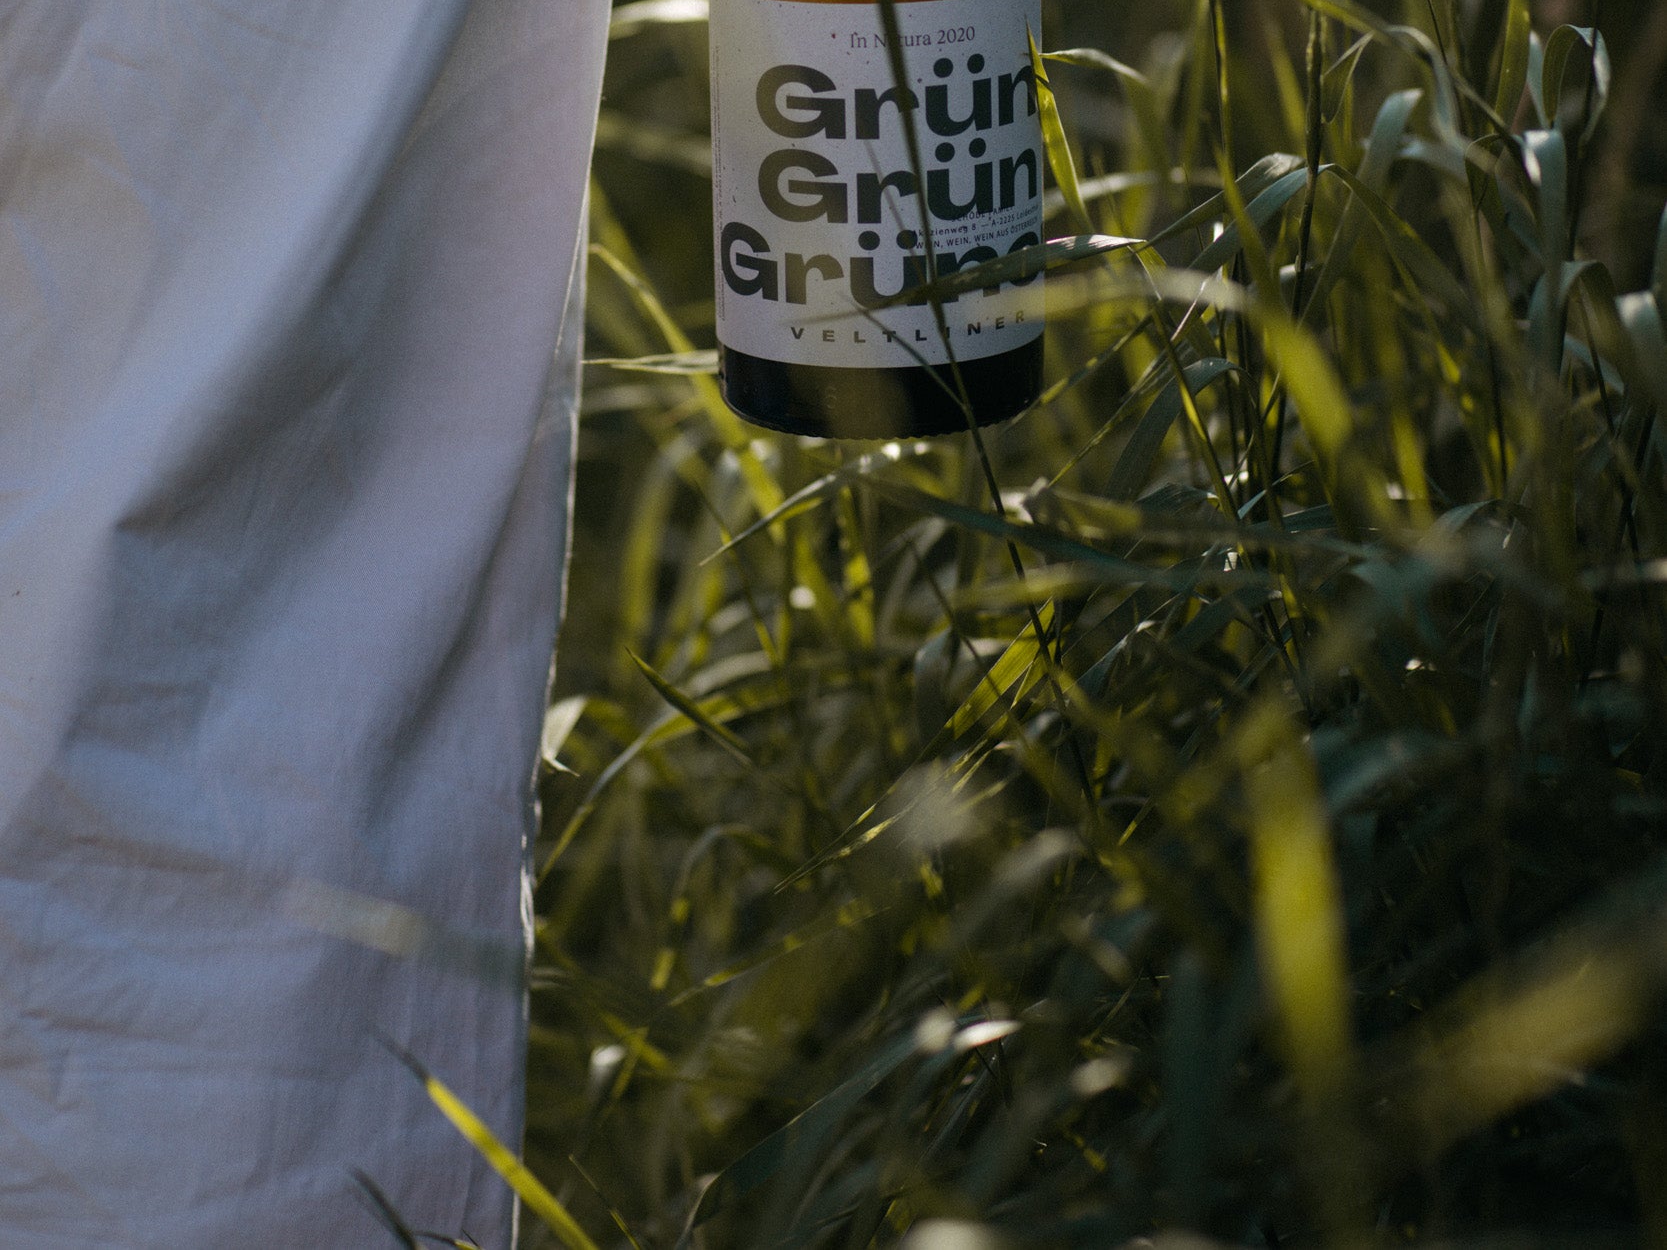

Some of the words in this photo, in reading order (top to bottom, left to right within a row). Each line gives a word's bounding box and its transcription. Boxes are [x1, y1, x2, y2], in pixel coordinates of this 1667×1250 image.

[874, 32, 932, 49] Ntura
[937, 26, 976, 45] 2020
[756, 53, 1037, 140] Grün
[758, 137, 1037, 224] Grün
[911, 225, 968, 237] Akzienweg
[915, 240, 943, 249] WN,
[974, 232, 994, 242] WEIN
[996, 227, 1009, 238] AUS
